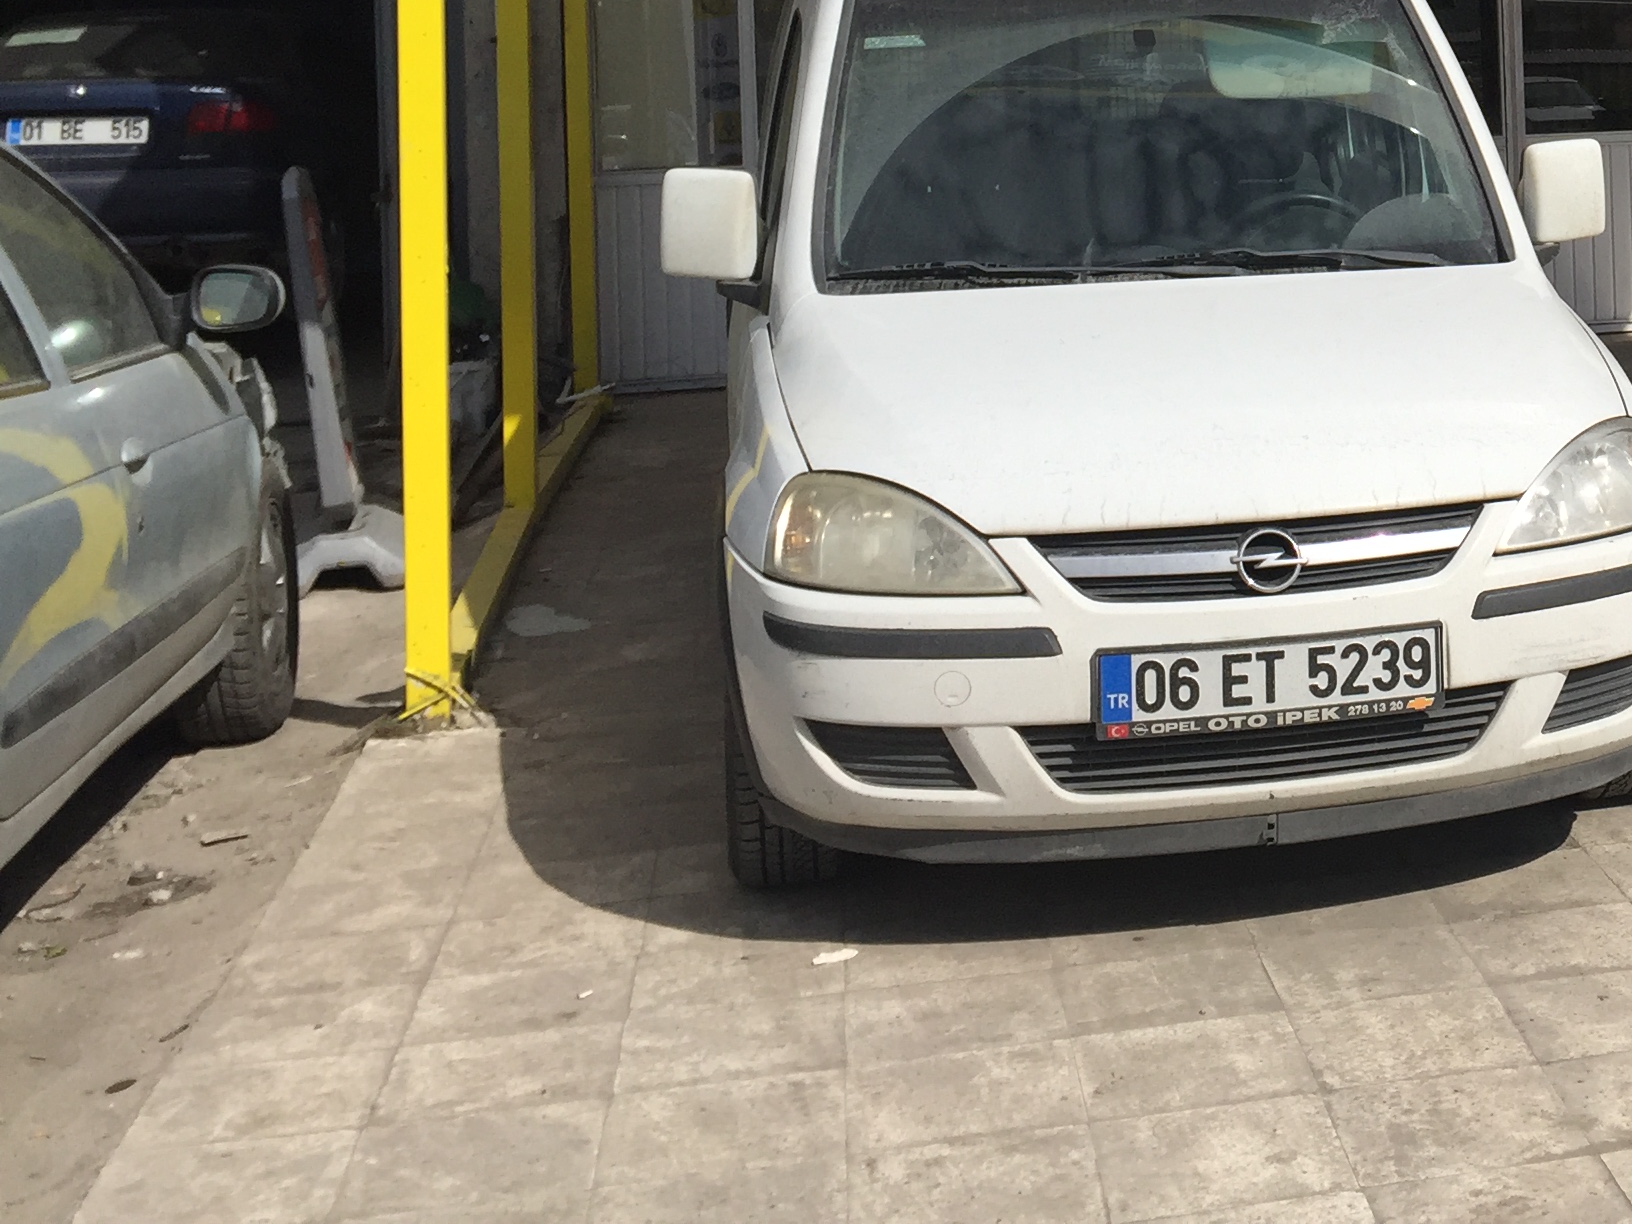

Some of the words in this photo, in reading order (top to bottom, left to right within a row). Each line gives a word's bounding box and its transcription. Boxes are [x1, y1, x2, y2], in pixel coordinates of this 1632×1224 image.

[22, 118, 43, 141] 01
[60, 118, 85, 141] BE
[111, 117, 144, 140] 515
[1134, 657, 1200, 714] 06
[1222, 650, 1285, 708] ET
[1307, 635, 1432, 700] 5239
[1107, 693, 1130, 710] TR
[1151, 721, 1201, 735] OPEL
[1207, 714, 1268, 732] OTO
[1347, 704, 1369, 717] 278
[1372, 702, 1387, 713] 13
[1389, 700, 1404, 712] 20
